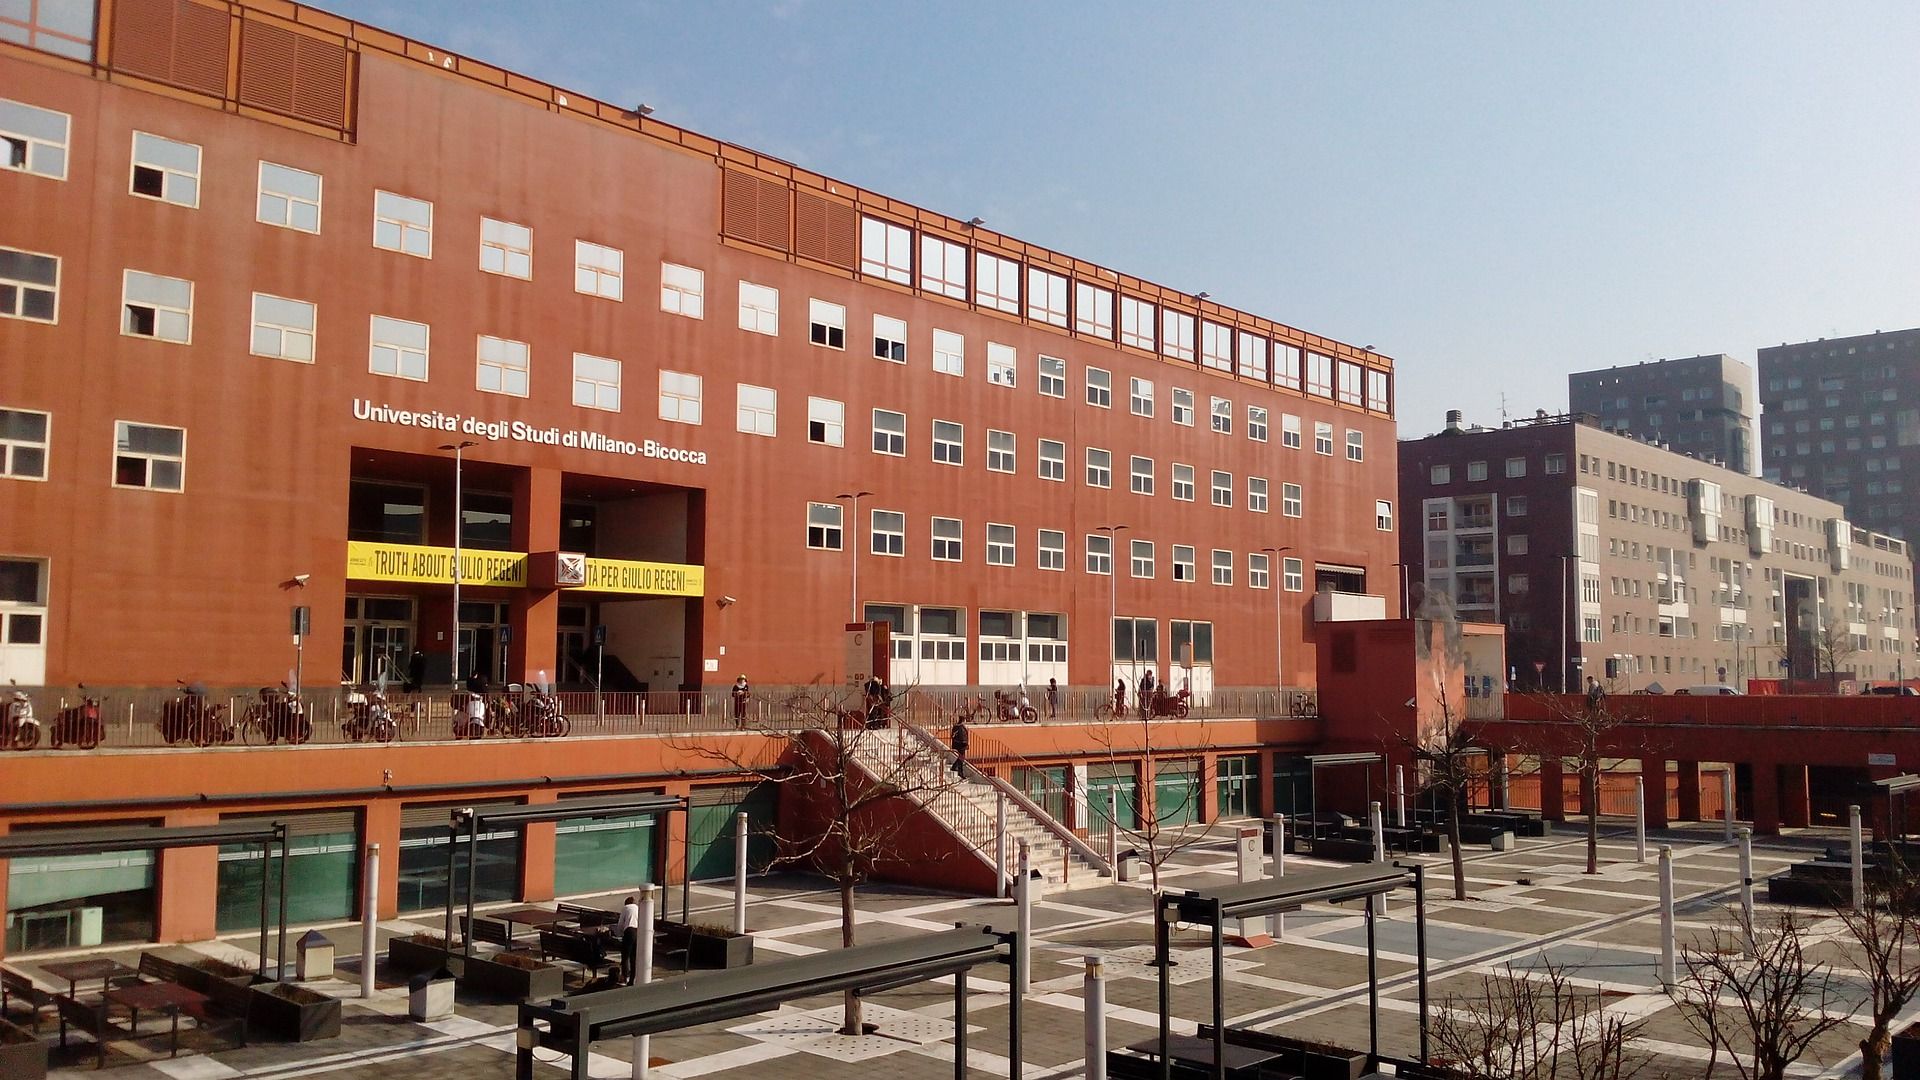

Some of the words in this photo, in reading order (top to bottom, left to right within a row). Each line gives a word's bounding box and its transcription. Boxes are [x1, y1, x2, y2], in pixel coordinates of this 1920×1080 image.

[353, 398, 460, 432] Universita'
[462, 416, 509, 441] degli
[511, 420, 560, 446] Studi
[562, 429, 578, 448] di
[580, 430, 707, 465] Milano-Bicocca
[374, 550, 409, 576] TRUTH
[411, 552, 447, 578] ABOUT
[449, 554, 483, 580] GULIO
[486, 557, 522, 582] REGENI
[601, 564, 619, 588] PER
[622, 566, 652, 590] GIULIO
[654, 569, 685, 592] REGENI
